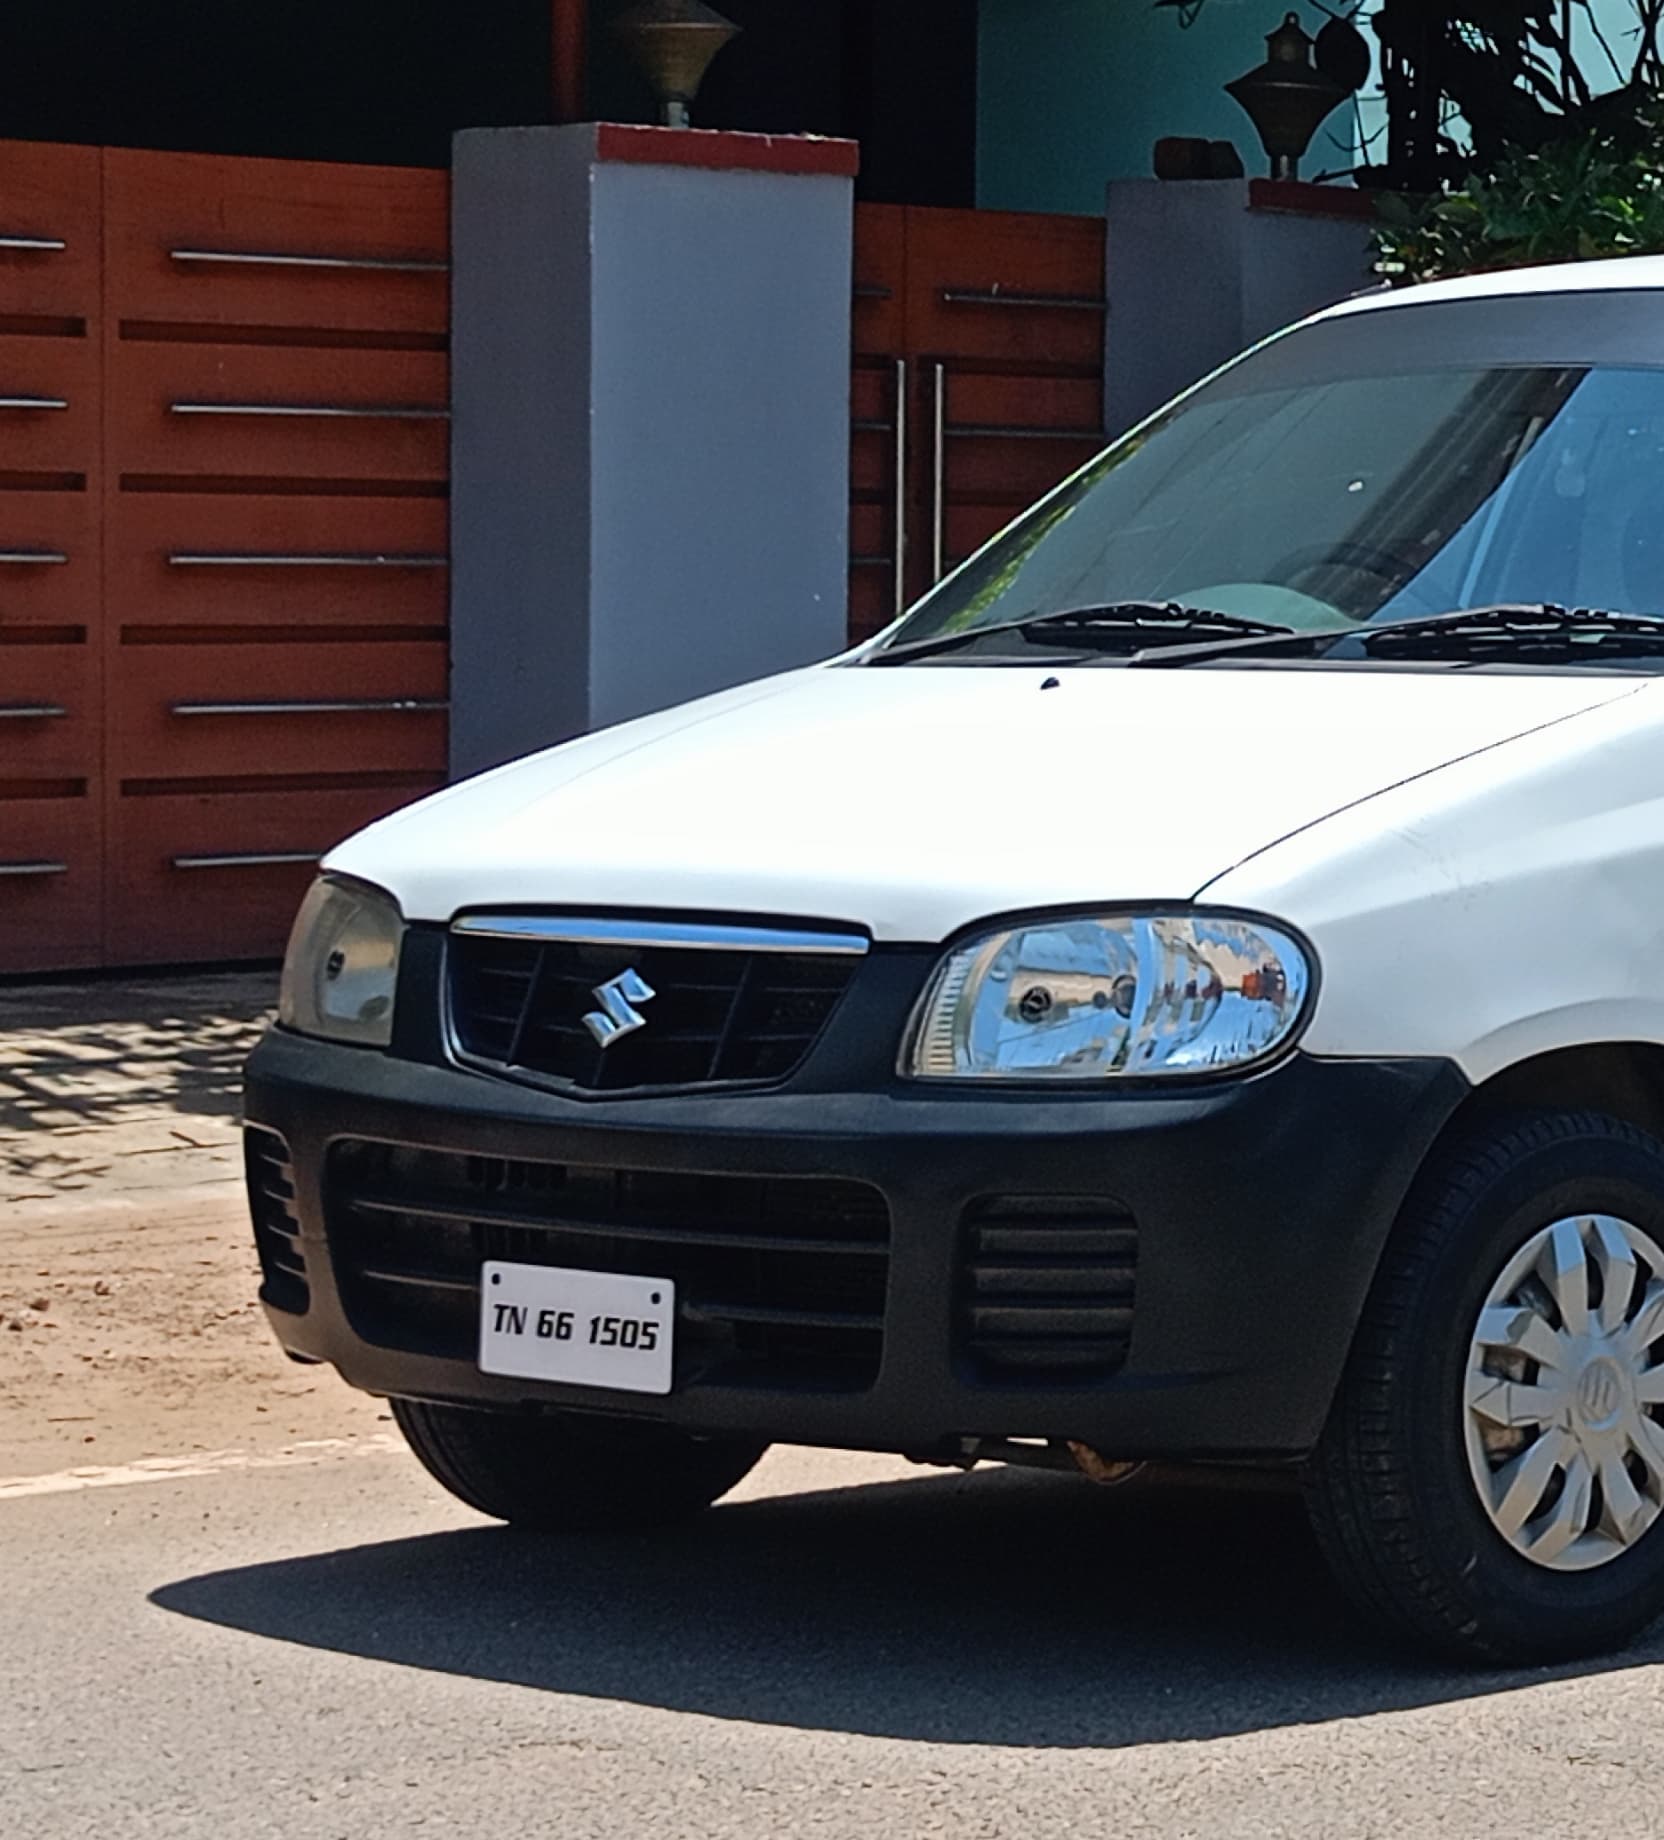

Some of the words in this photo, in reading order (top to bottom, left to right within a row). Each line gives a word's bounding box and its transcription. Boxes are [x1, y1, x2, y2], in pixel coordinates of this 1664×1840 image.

[494, 1304, 528, 1335] TN
[536, 1310, 575, 1341] 66
[589, 1315, 660, 1351] 1505
